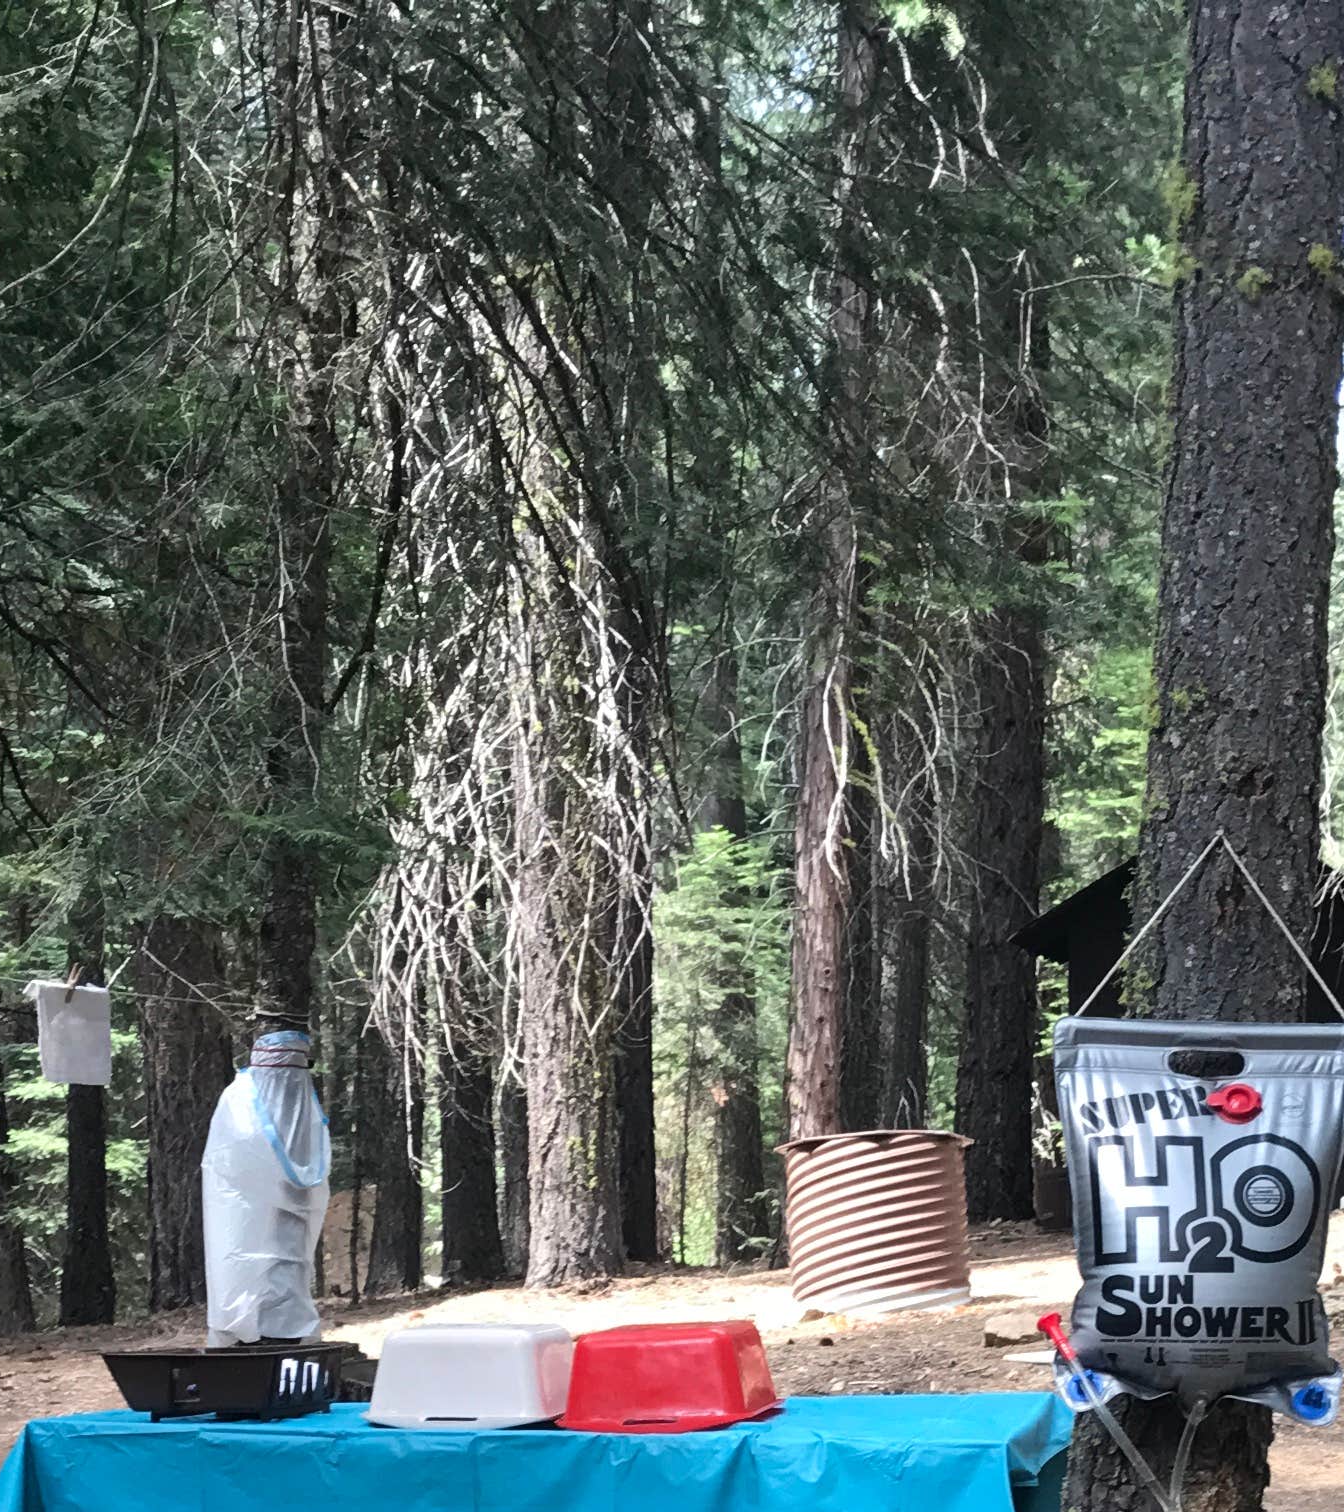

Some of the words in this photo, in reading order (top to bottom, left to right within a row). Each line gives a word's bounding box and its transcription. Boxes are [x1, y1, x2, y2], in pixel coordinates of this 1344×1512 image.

[1080, 1085, 1214, 1135] SUPER
[1088, 1133, 1321, 1273] H2O
[1096, 1274, 1294, 1344] SHOWER
